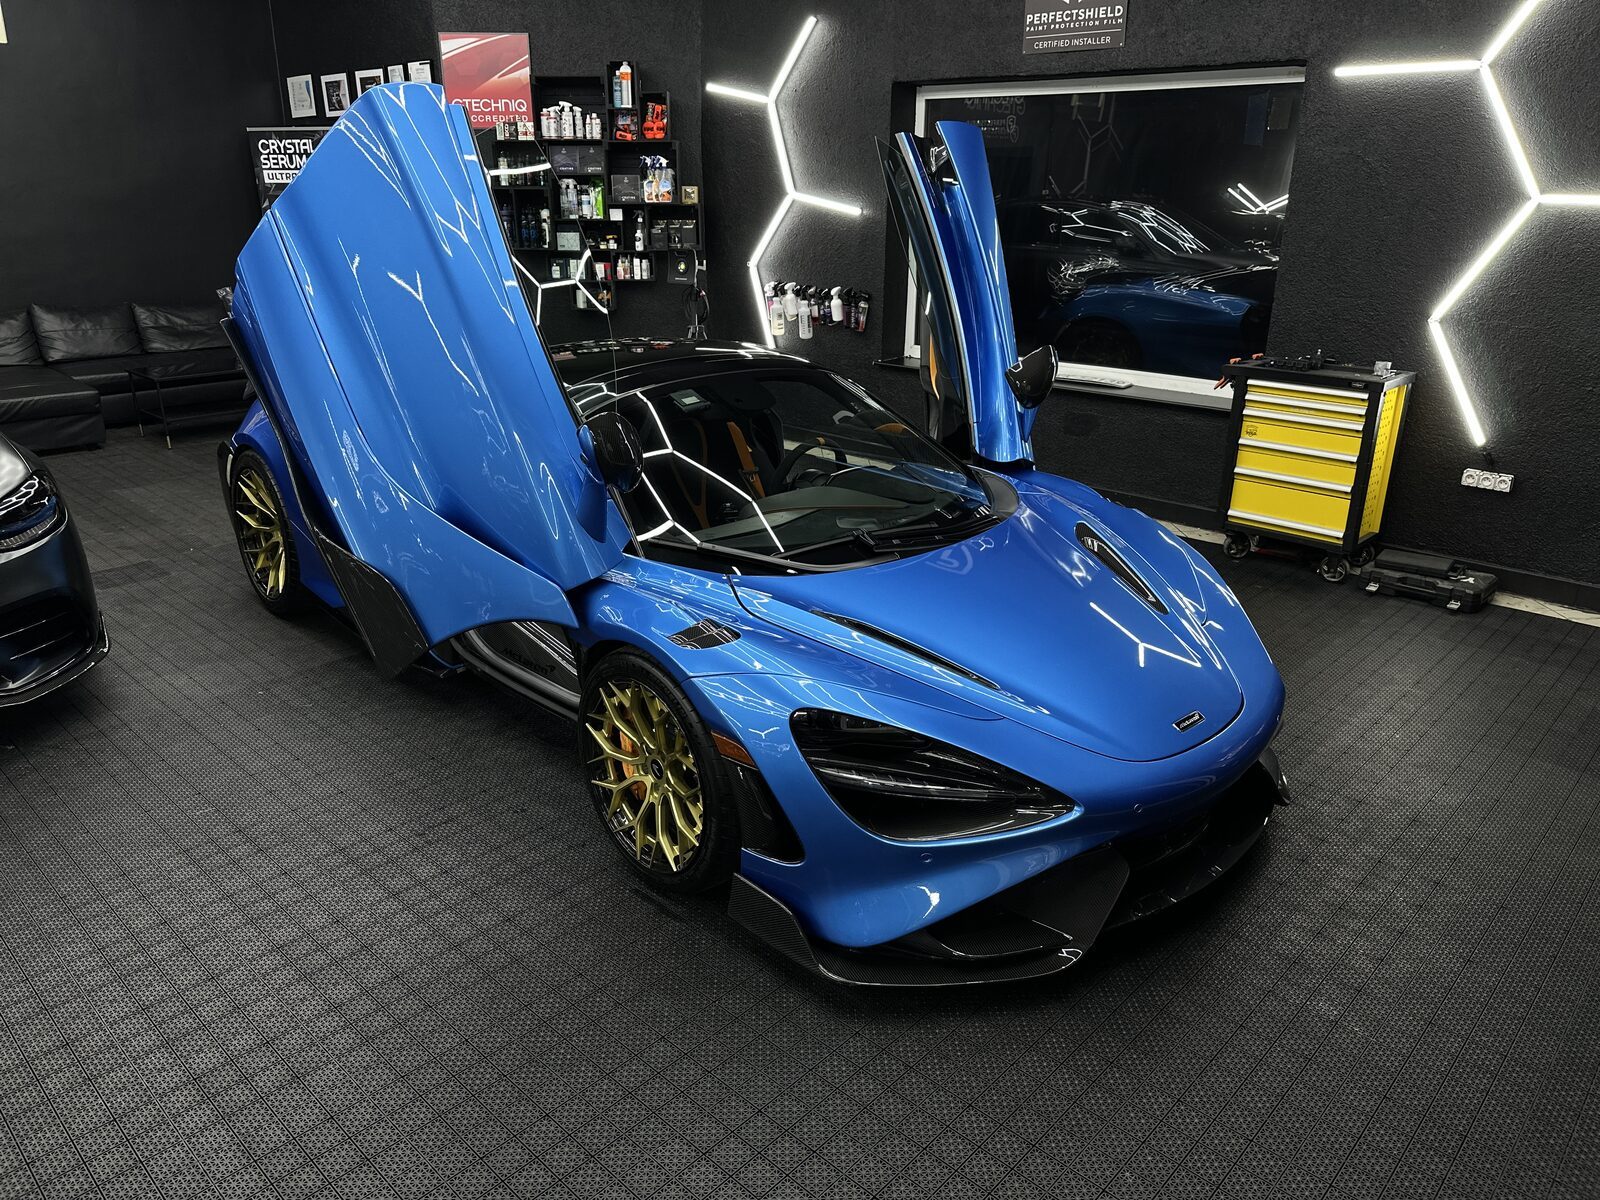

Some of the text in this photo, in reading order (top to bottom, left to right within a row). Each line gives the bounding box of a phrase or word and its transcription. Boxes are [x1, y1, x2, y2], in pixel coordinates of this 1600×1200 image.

[1026, 5, 1124, 25] PERFECTSHIELD
[1025, 24, 1047, 32] PAINT
[1050, 20, 1100, 29] PROTECTION
[1033, 36, 1111, 49] CERTIFIED INSTALLER
[470, 114, 529, 122] CCREDITED
[258, 139, 314, 154] CRYSTAL
[260, 154, 307, 169] SERUM
